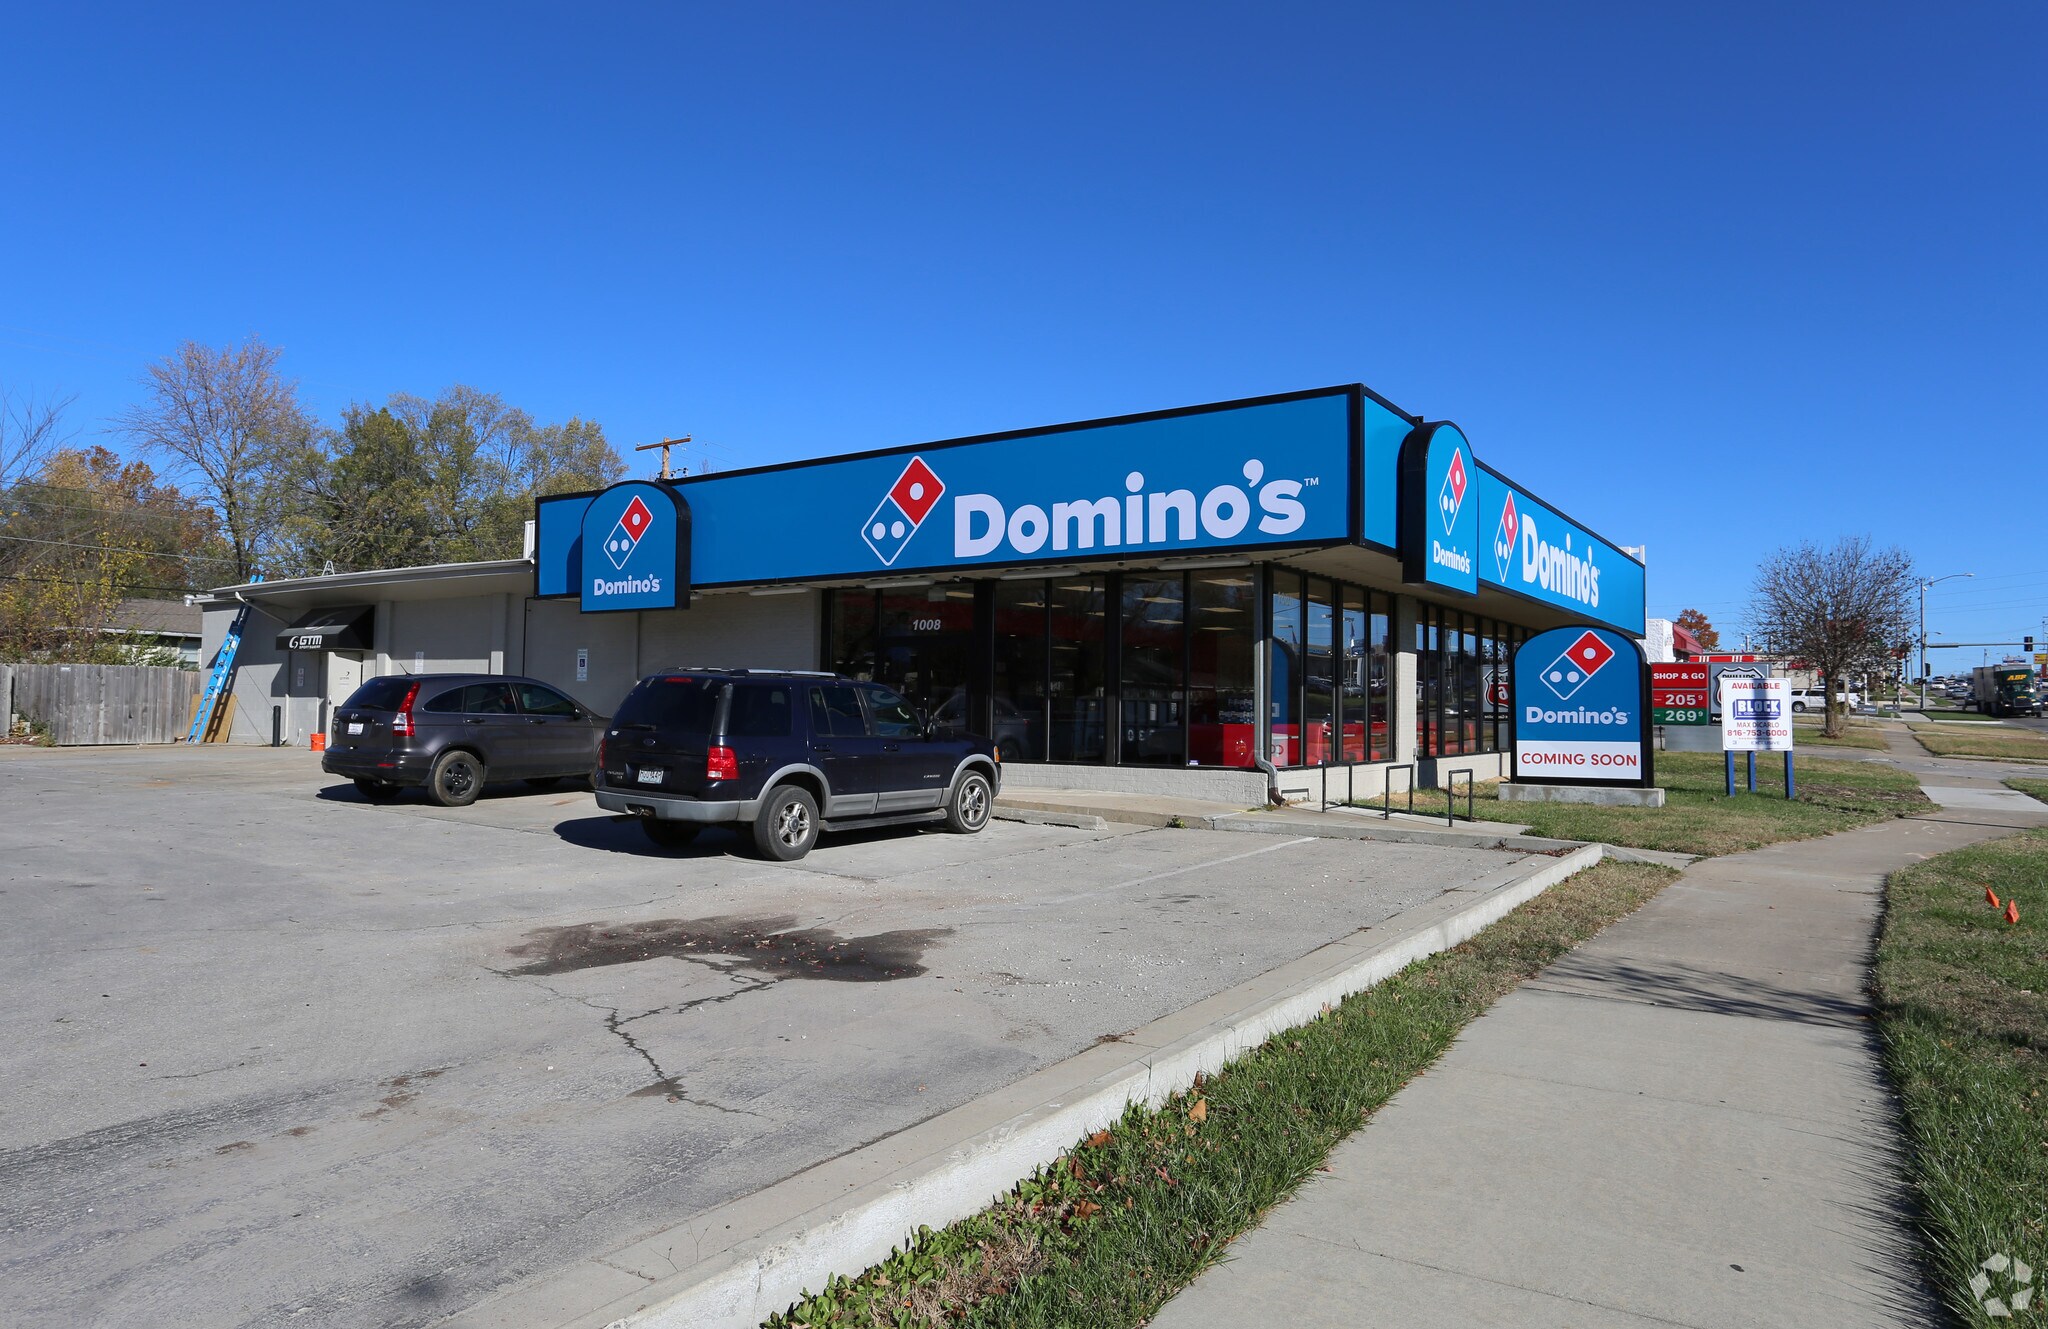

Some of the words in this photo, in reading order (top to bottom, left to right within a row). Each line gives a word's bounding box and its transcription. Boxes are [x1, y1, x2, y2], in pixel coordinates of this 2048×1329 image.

[954, 458, 1306, 558] Domino's
[1433, 539, 1471, 575] Domino's
[1522, 513, 1599, 608] Domino's
[593, 573, 660, 596] Domino's
[912, 619, 941, 631] 1008
[299, 635, 322, 645] GTM
[1653, 672, 1679, 680] SHOP
[1681, 672, 1689, 680] &
[1691, 672, 1705, 680] GO
[1731, 682, 1780, 690] AVAILABLE
[1665, 694, 1697, 706] 205
[1737, 700, 1780, 712] BLOCK
[1526, 706, 1628, 725] Domino's
[1665, 710, 1697, 722] 269
[1727, 729, 1788, 737] 816-753-6000
[1521, 753, 1586, 765] COMING
[1591, 754, 1637, 766] SOON
